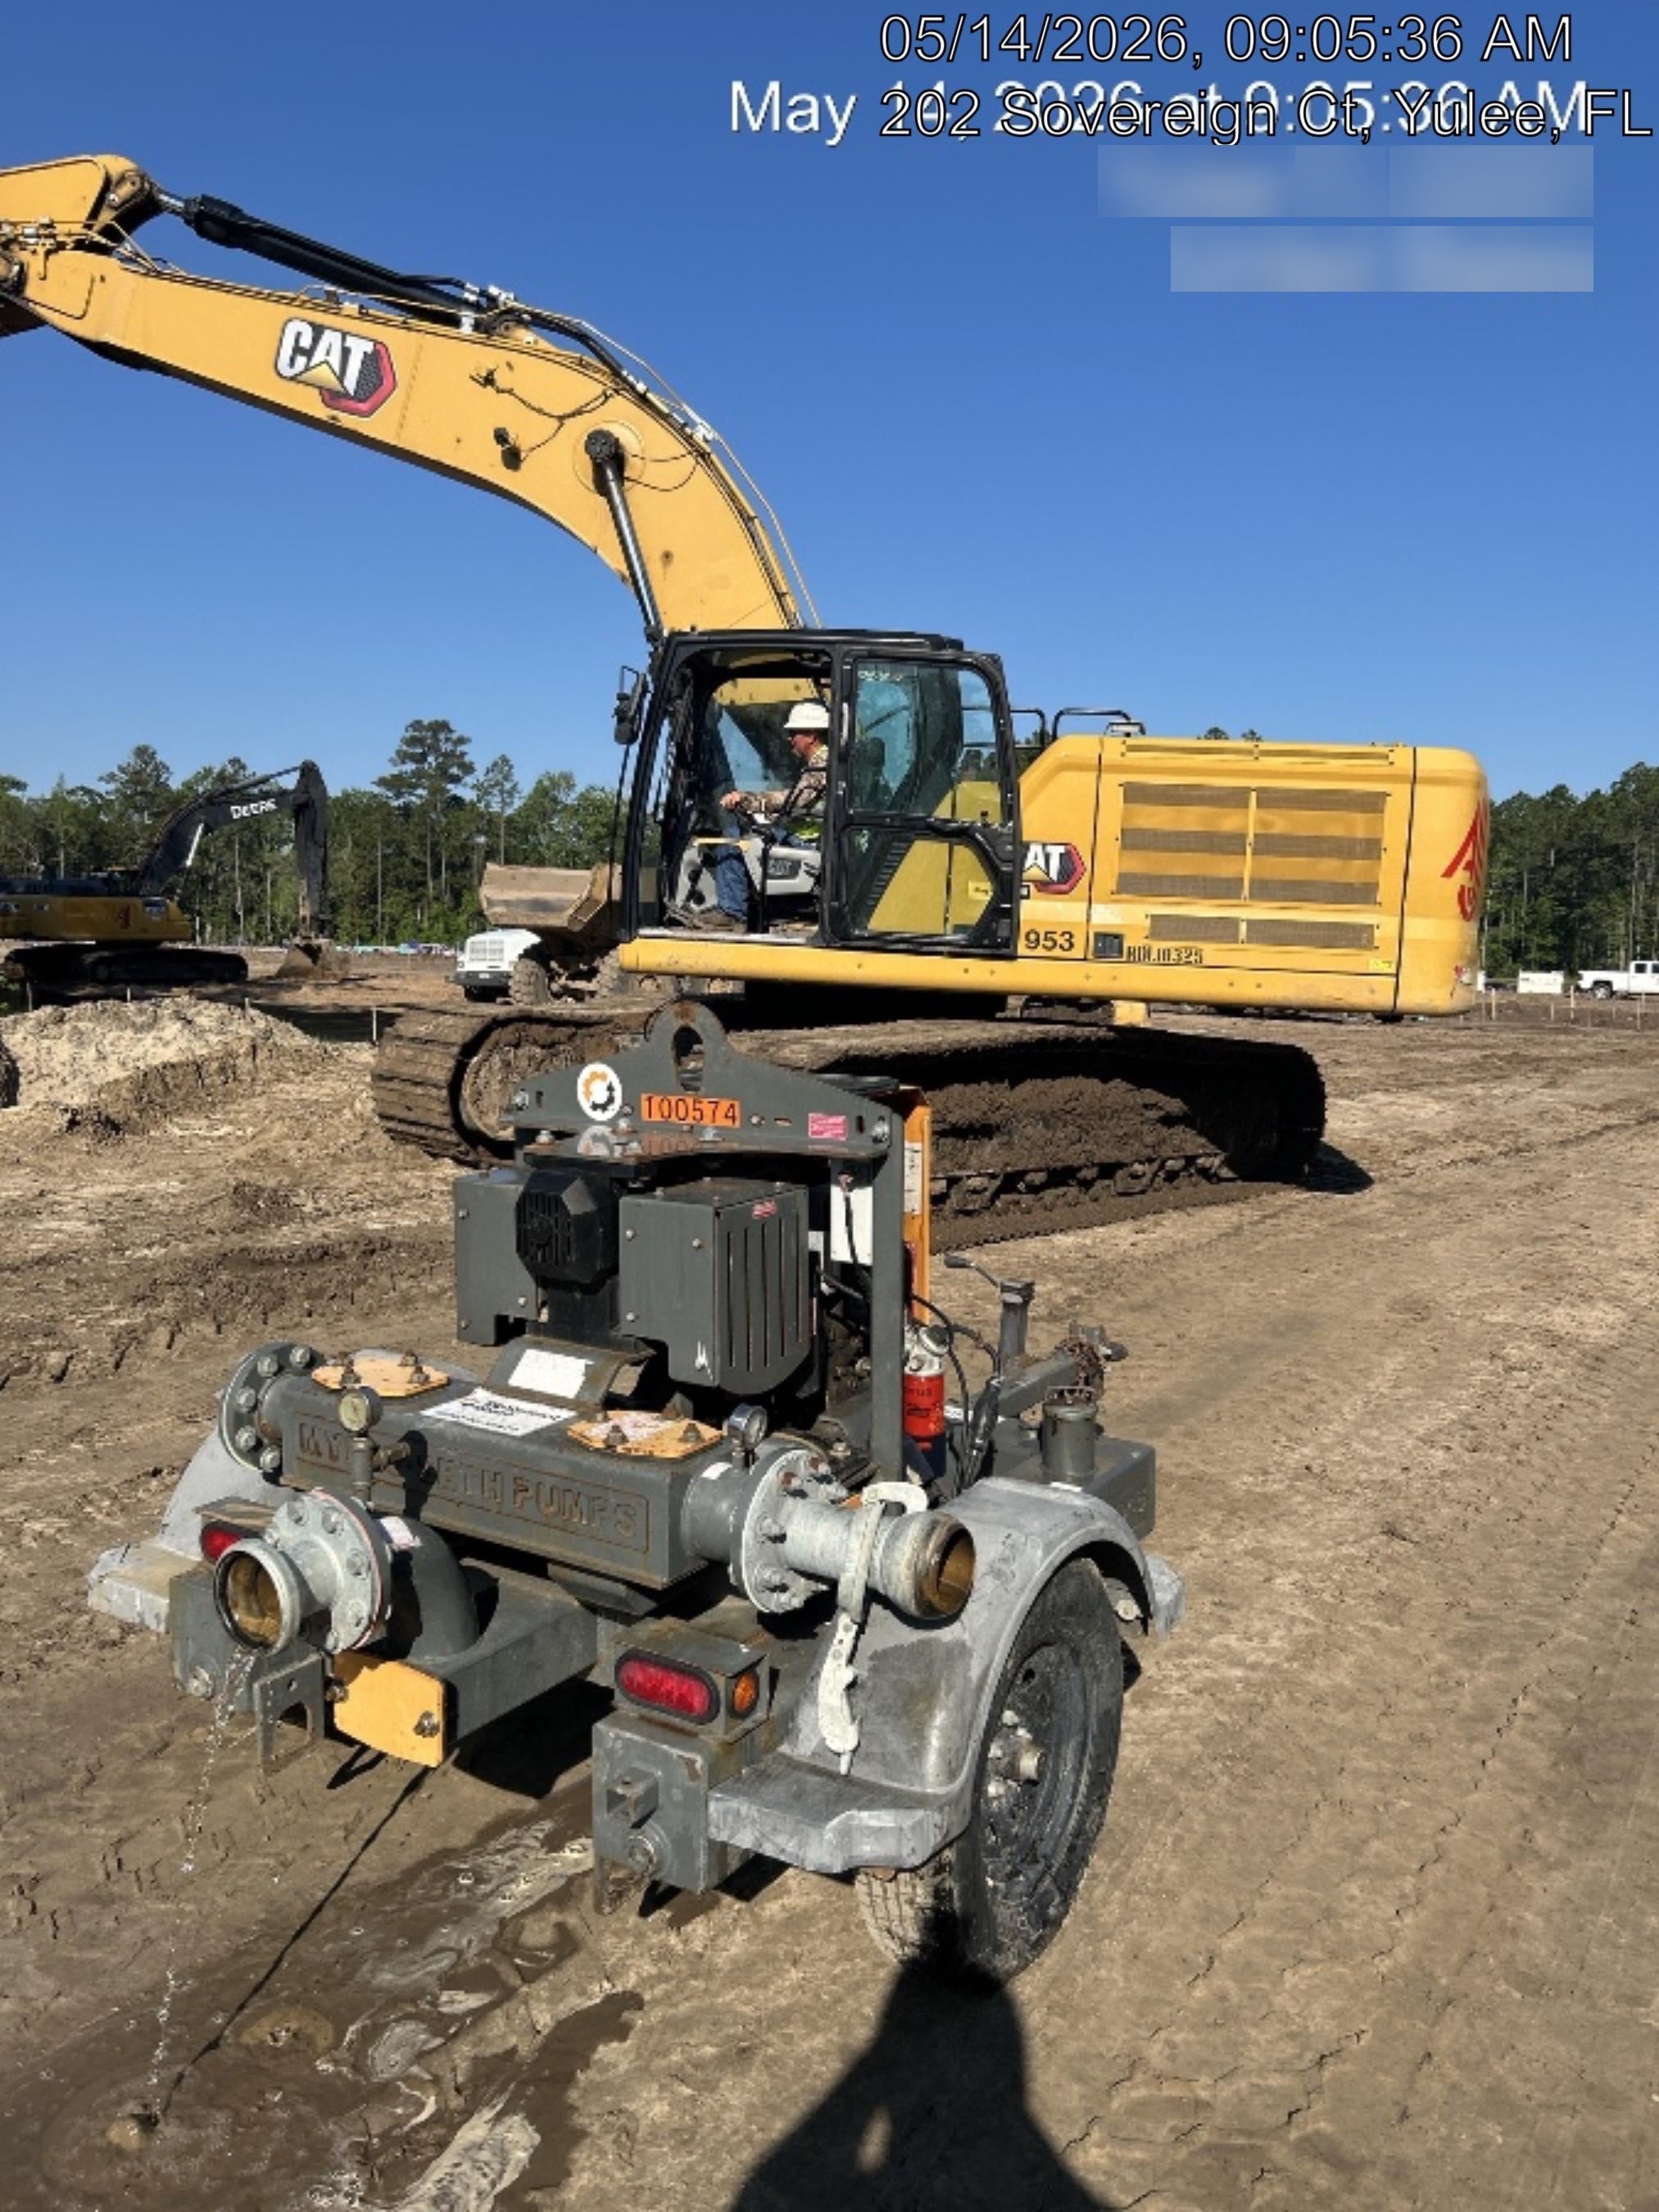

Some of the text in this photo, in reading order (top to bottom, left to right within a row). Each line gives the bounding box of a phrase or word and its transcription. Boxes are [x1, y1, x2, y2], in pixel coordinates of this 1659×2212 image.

[277, 319, 375, 397] CAT
[1024, 842, 1065, 882] AT
[1024, 928, 1076, 952] 953
[644, 1094, 738, 1126] 100574
